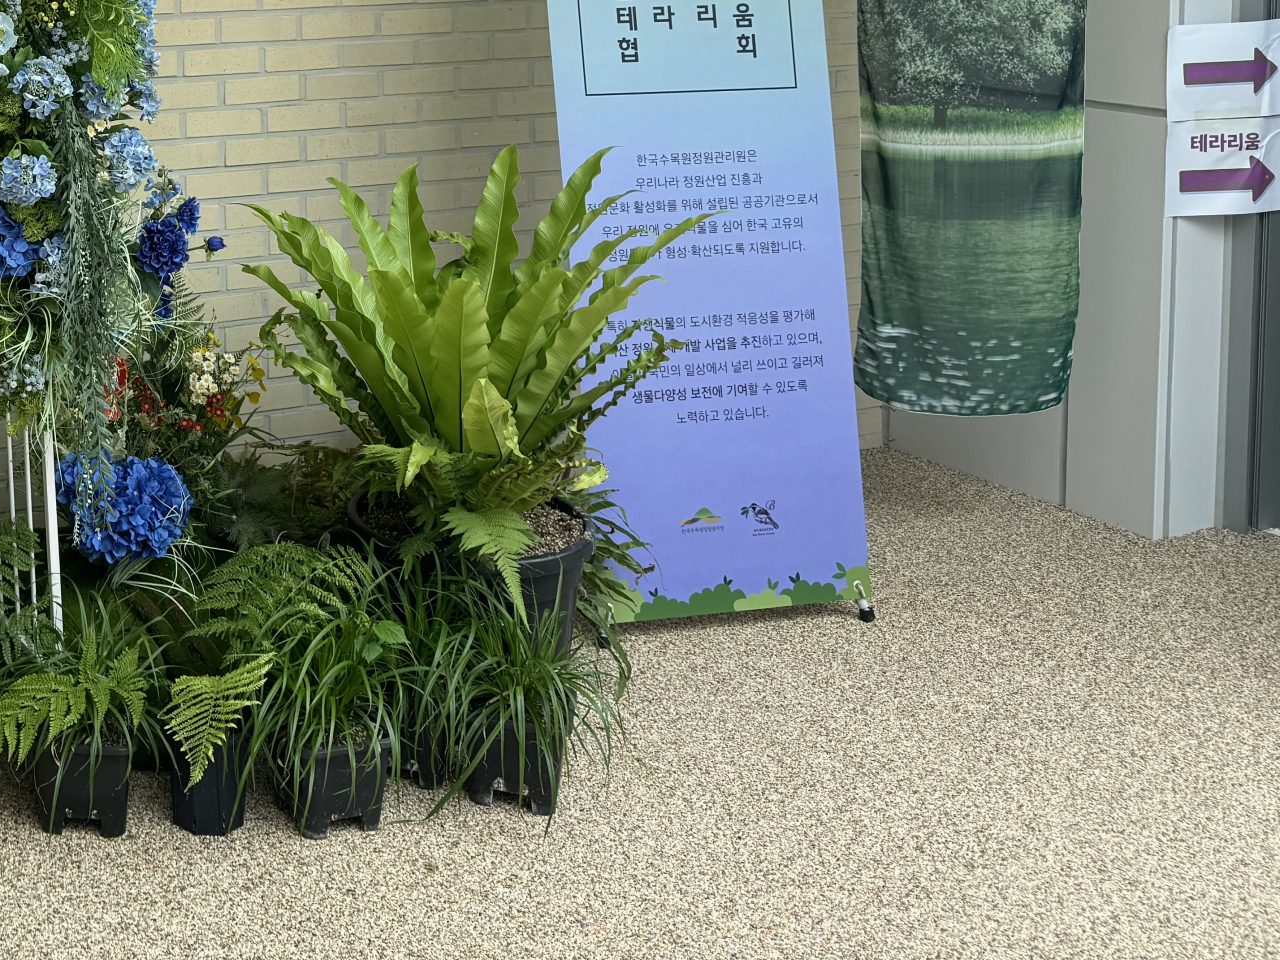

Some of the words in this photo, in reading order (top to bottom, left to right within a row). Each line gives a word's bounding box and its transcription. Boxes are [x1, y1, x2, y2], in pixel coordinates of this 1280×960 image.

[1190, 132, 1261, 153] 테라리움
[636, 149, 758, 167] 한국수목원정원관리원은
[635, 175, 680, 190] 우리나라
[682, 173, 727, 188] 정원산업
[730, 172, 763, 187] 진흥과
[633, 199, 678, 214] 활성화를
[681, 197, 703, 211] 위해
[706, 196, 739, 211] 설립된
[742, 192, 819, 209] 공공기관으로서
[602, 224, 623, 239] 우리
[721, 219, 743, 234] 심어
[746, 217, 768, 232] 한국
[771, 216, 804, 231] 고유의
[748, 239, 806, 255] 지원합니다.
[689, 314, 733, 329] 도시환경
[736, 310, 780, 326] 적응성을
[782, 308, 816, 323] 평가해
[704, 336, 737, 351] 사업을
[740, 333, 783, 349] 추진하고
[786, 331, 822, 347] 있으며,
[684, 361, 728, 377] 일상에서
[731, 359, 753, 374] 널리
[756, 357, 789, 372] 쓰이고
[791, 354, 824, 370] 길러져
[632, 387, 687, 404] 생물다양성
[690, 384, 723, 400] 보전에
[726, 382, 759, 398] 기여할
[761, 382, 773, 395] 수
[775, 379, 808, 394] 있도록
[676, 409, 720, 424] 노력하고
[723, 405, 770, 422] 있습니다.
